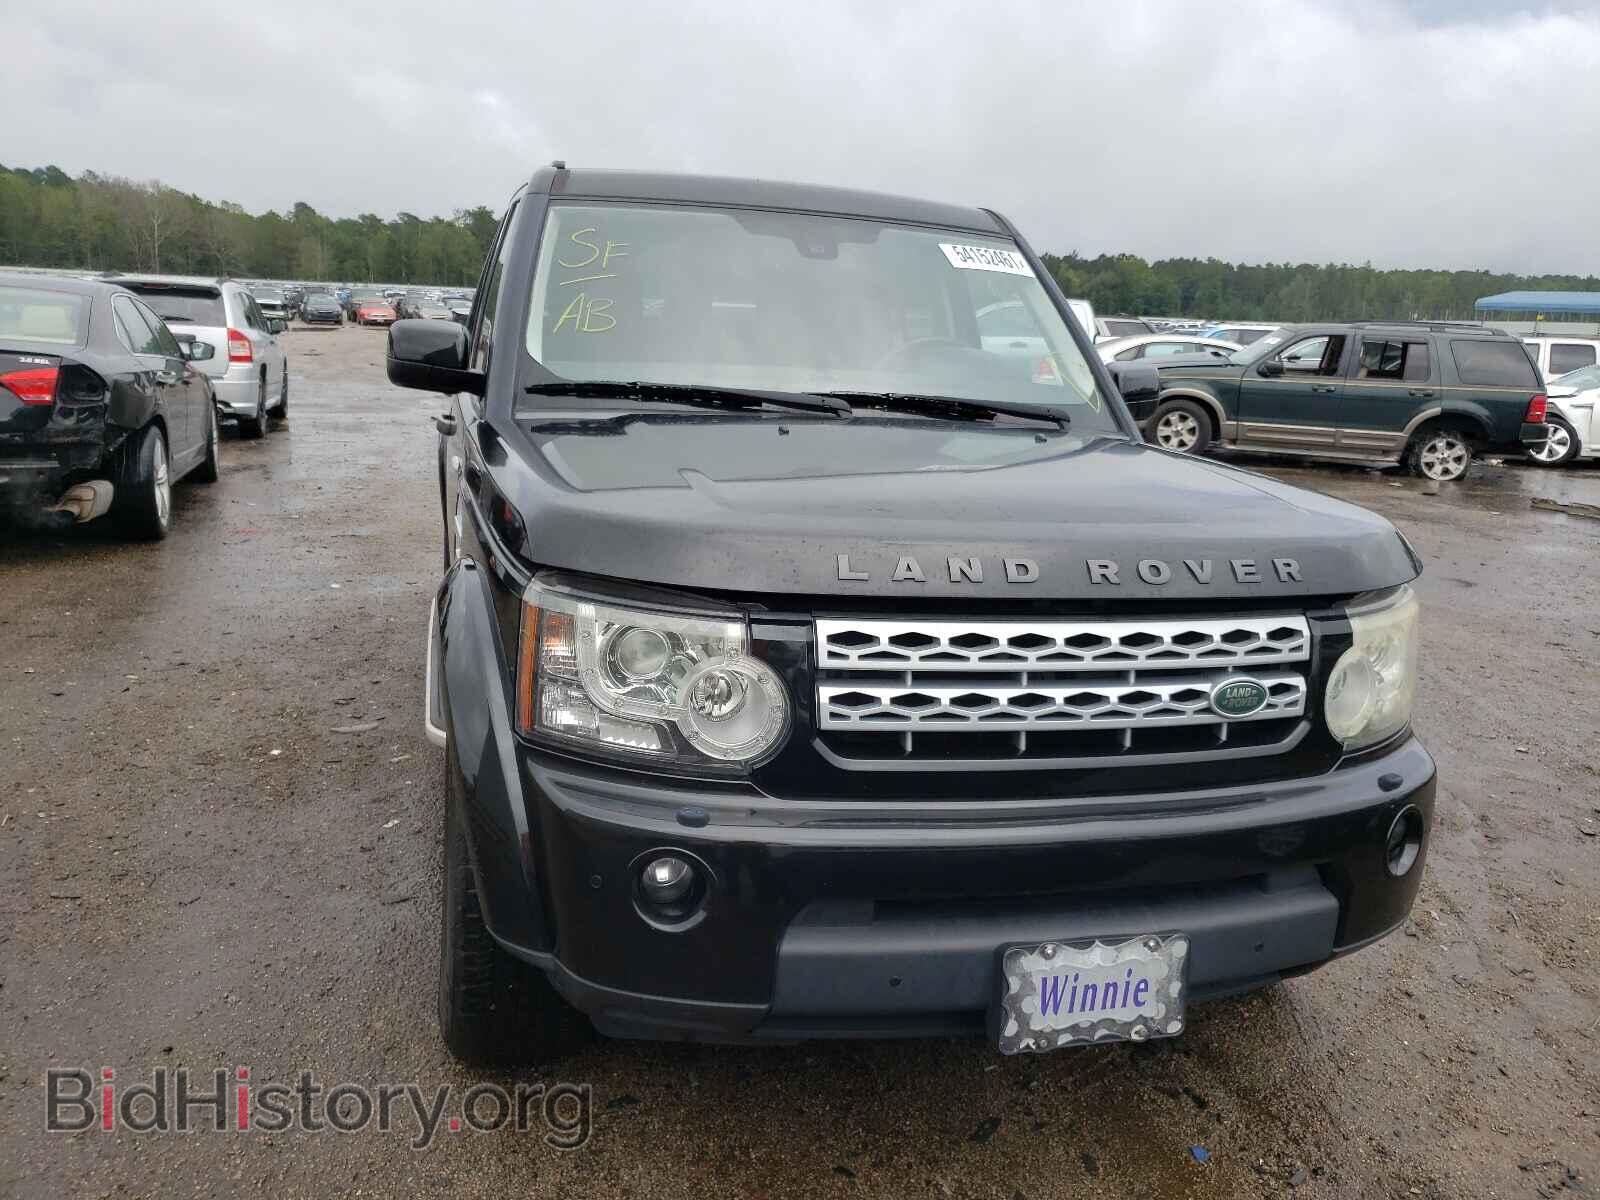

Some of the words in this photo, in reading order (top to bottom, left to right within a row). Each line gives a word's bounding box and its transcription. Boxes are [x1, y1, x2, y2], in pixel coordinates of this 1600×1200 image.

[558, 227, 631, 270] SF
[552, 292, 617, 333] AB
[836, 554, 1040, 584] LAND
[1085, 557, 1305, 586] ROVER
[1225, 687, 1252, 698] LAND
[1039, 967, 1149, 1017] Winnie
